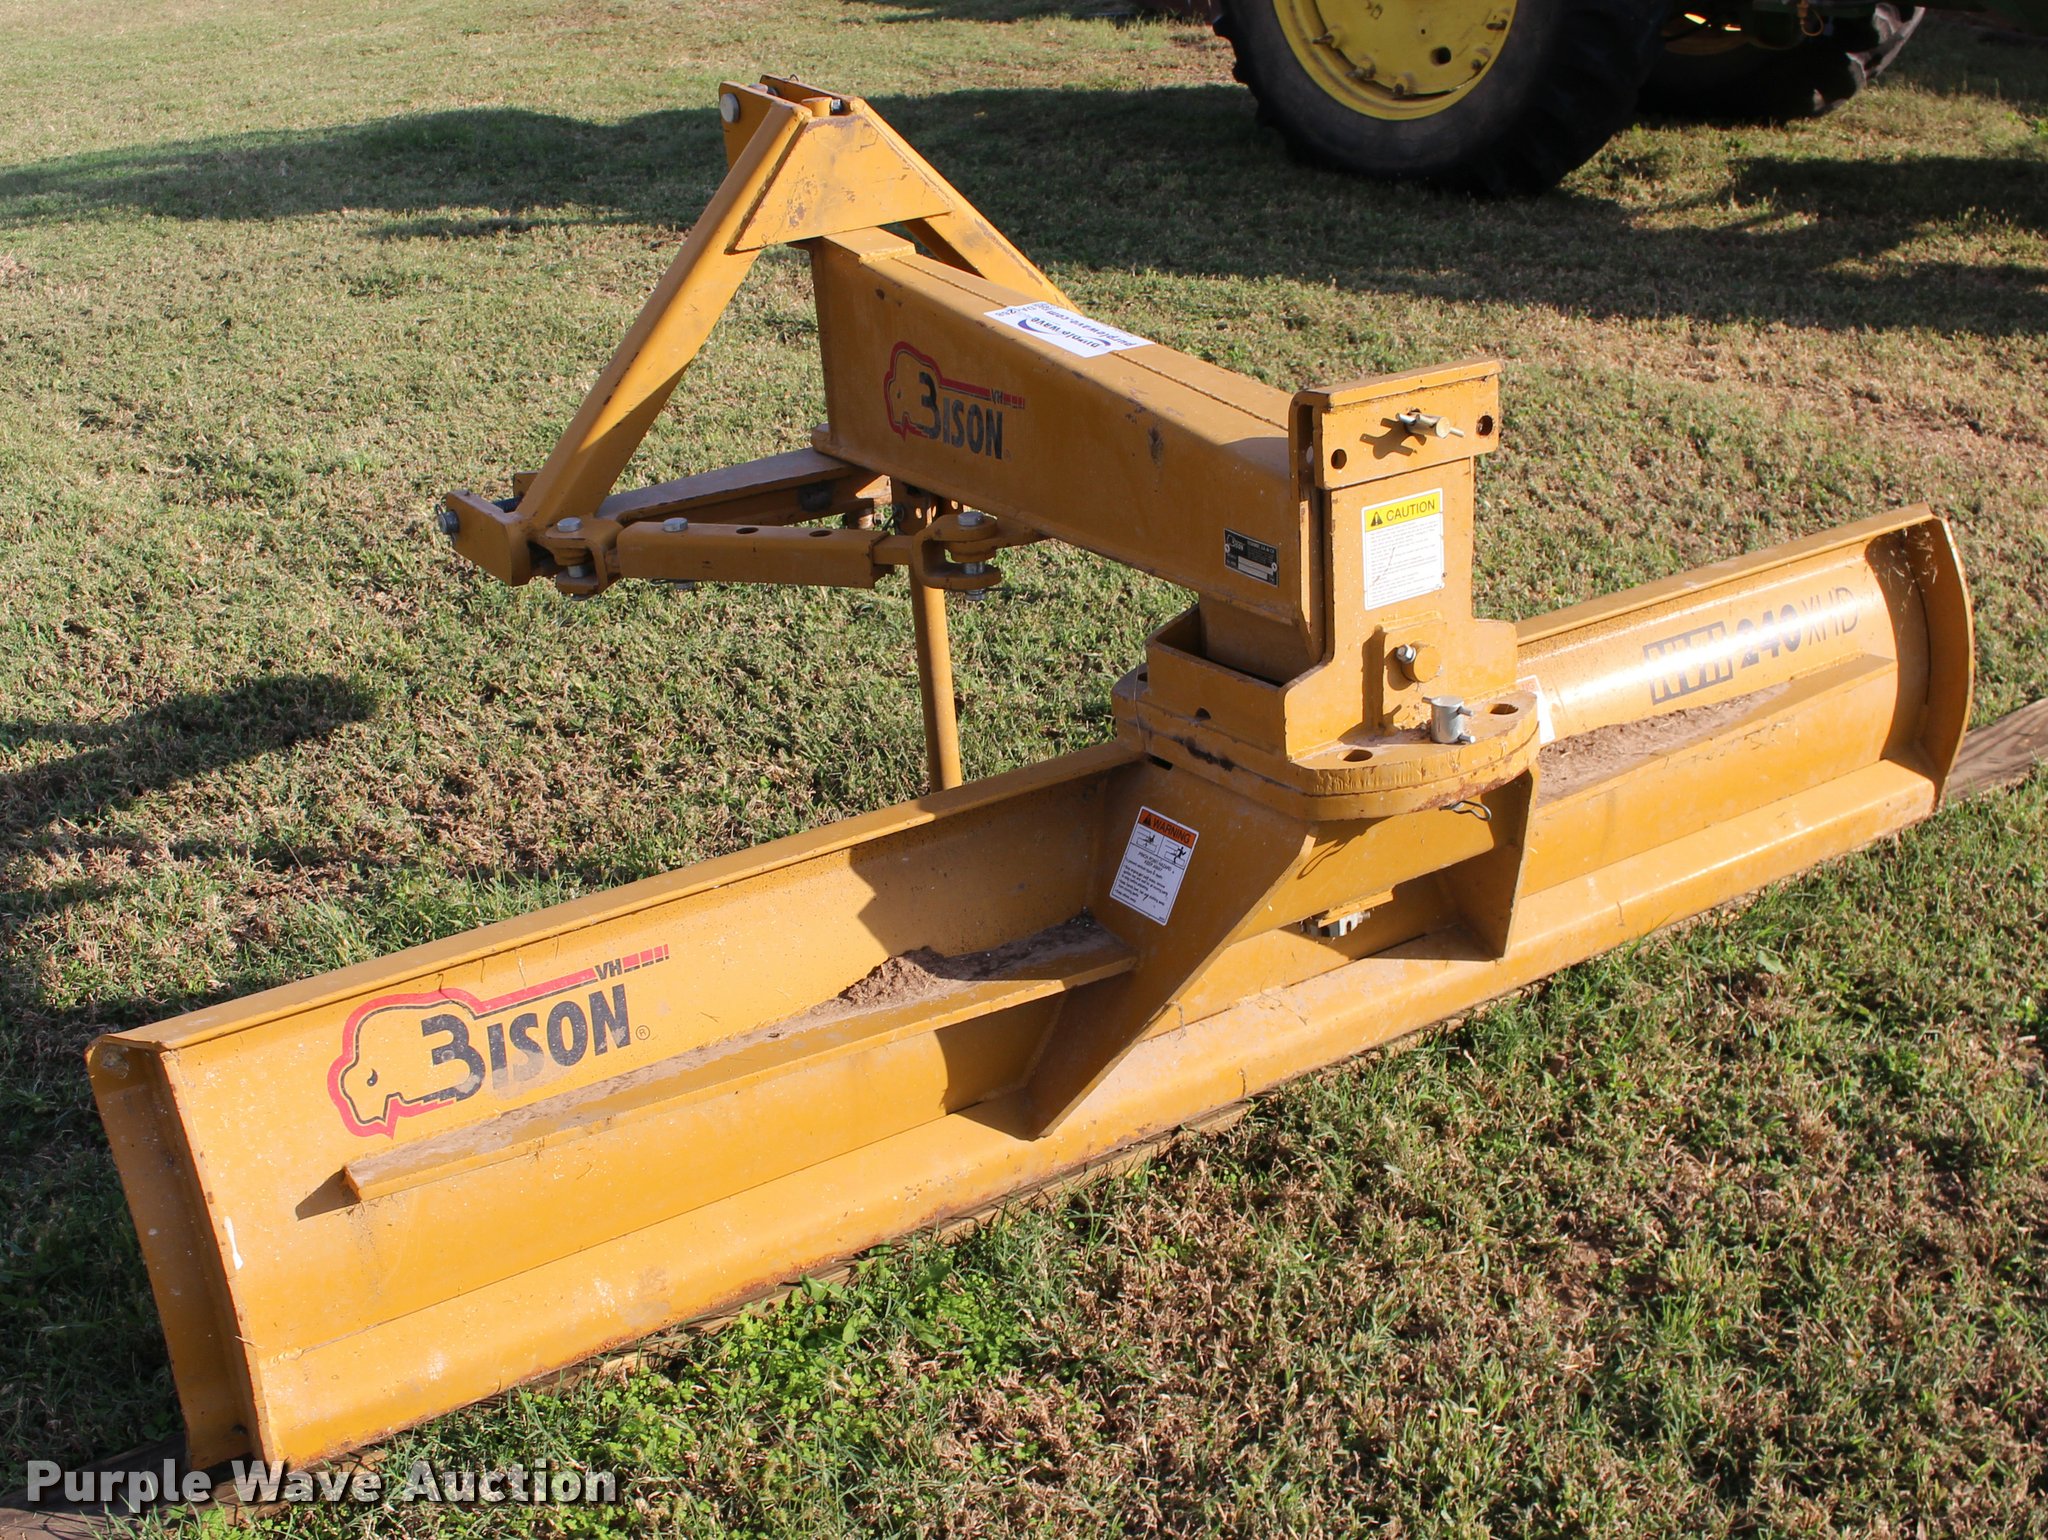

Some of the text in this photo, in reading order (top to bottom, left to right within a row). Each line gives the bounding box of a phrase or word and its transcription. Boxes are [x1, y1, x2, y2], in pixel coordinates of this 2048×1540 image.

[1031, 316, 1101, 348] purple wave
[918, 371, 1003, 460] BISON
[1386, 499, 1436, 522] CAUTION
[1152, 819, 1191, 844] WARNING
[595, 957, 623, 981] VH
[421, 983, 632, 1103] BISON
